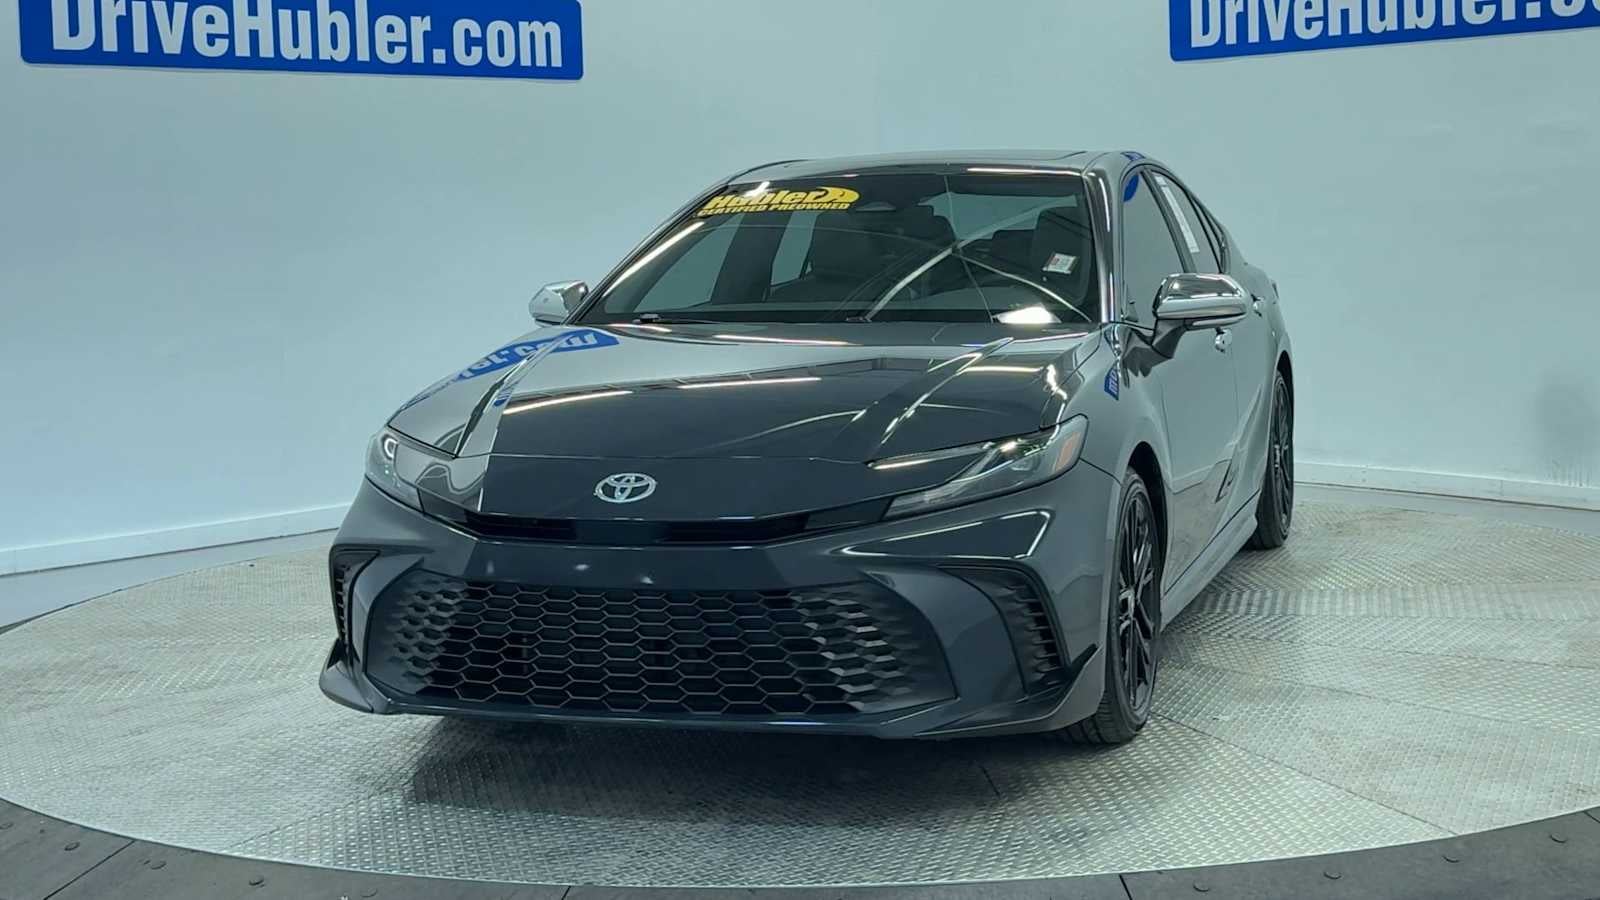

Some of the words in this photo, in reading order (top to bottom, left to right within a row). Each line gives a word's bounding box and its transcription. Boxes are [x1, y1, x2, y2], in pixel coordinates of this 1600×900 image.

[51, 0, 563, 67] DriveHubler.com
[1190, 0, 1600, 48] DriveHube.
[697, 205, 767, 217] CERTIFIED
[769, 202, 850, 210] PREOWNED
